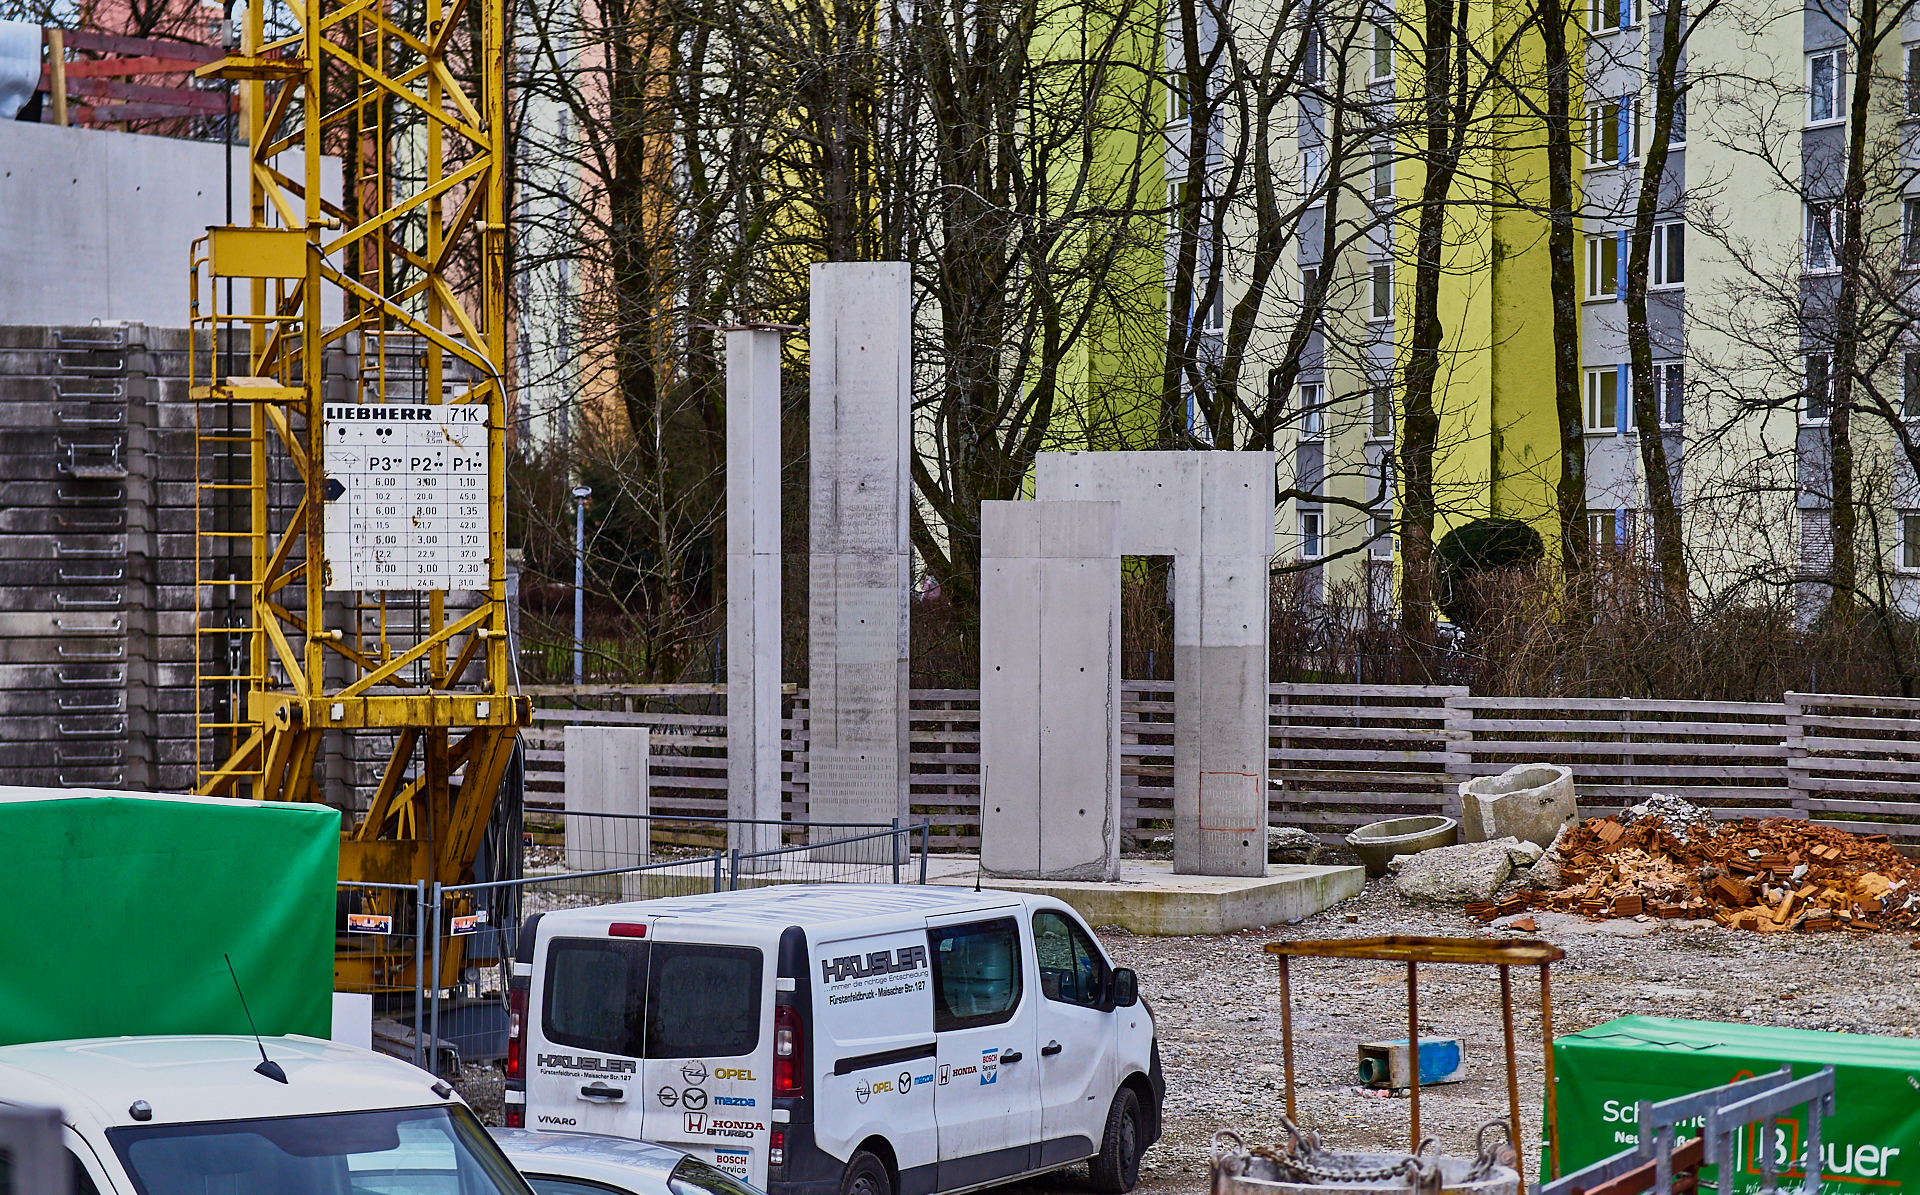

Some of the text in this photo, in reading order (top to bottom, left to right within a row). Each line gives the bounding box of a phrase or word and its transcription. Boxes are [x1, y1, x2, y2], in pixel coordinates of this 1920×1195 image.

[327, 407, 478, 421] LIEBHERR 71K
[370, 457, 471, 471] P3 P2 P1
[821, 944, 928, 984] HÄUSLER
[853, 980, 863, 988] die
[864, 976, 888, 985] richtige
[888, 970, 929, 982] Entscheidung
[829, 989, 875, 1006] Fürstenfeldbruck
[878, 986, 904, 998] Maisacher
[915, 980, 925, 991] 127
[537, 1053, 637, 1074] HÄUSLER
[982, 1054, 997, 1063] BOSCH
[714, 1067, 756, 1080] OPEL
[952, 1065, 978, 1077] HONDA
[982, 1063, 997, 1072] Service
[540, 1068, 580, 1077] Fürstenfeldbruck
[583, 1072, 609, 1080] Maisacher
[872, 1081, 894, 1094] OPEL
[537, 1115, 577, 1126] VIVARO
[712, 1120, 765, 1130] HONDA
[707, 1128, 754, 1139] BITURBO
[716, 1155, 747, 1165] BOSCH
